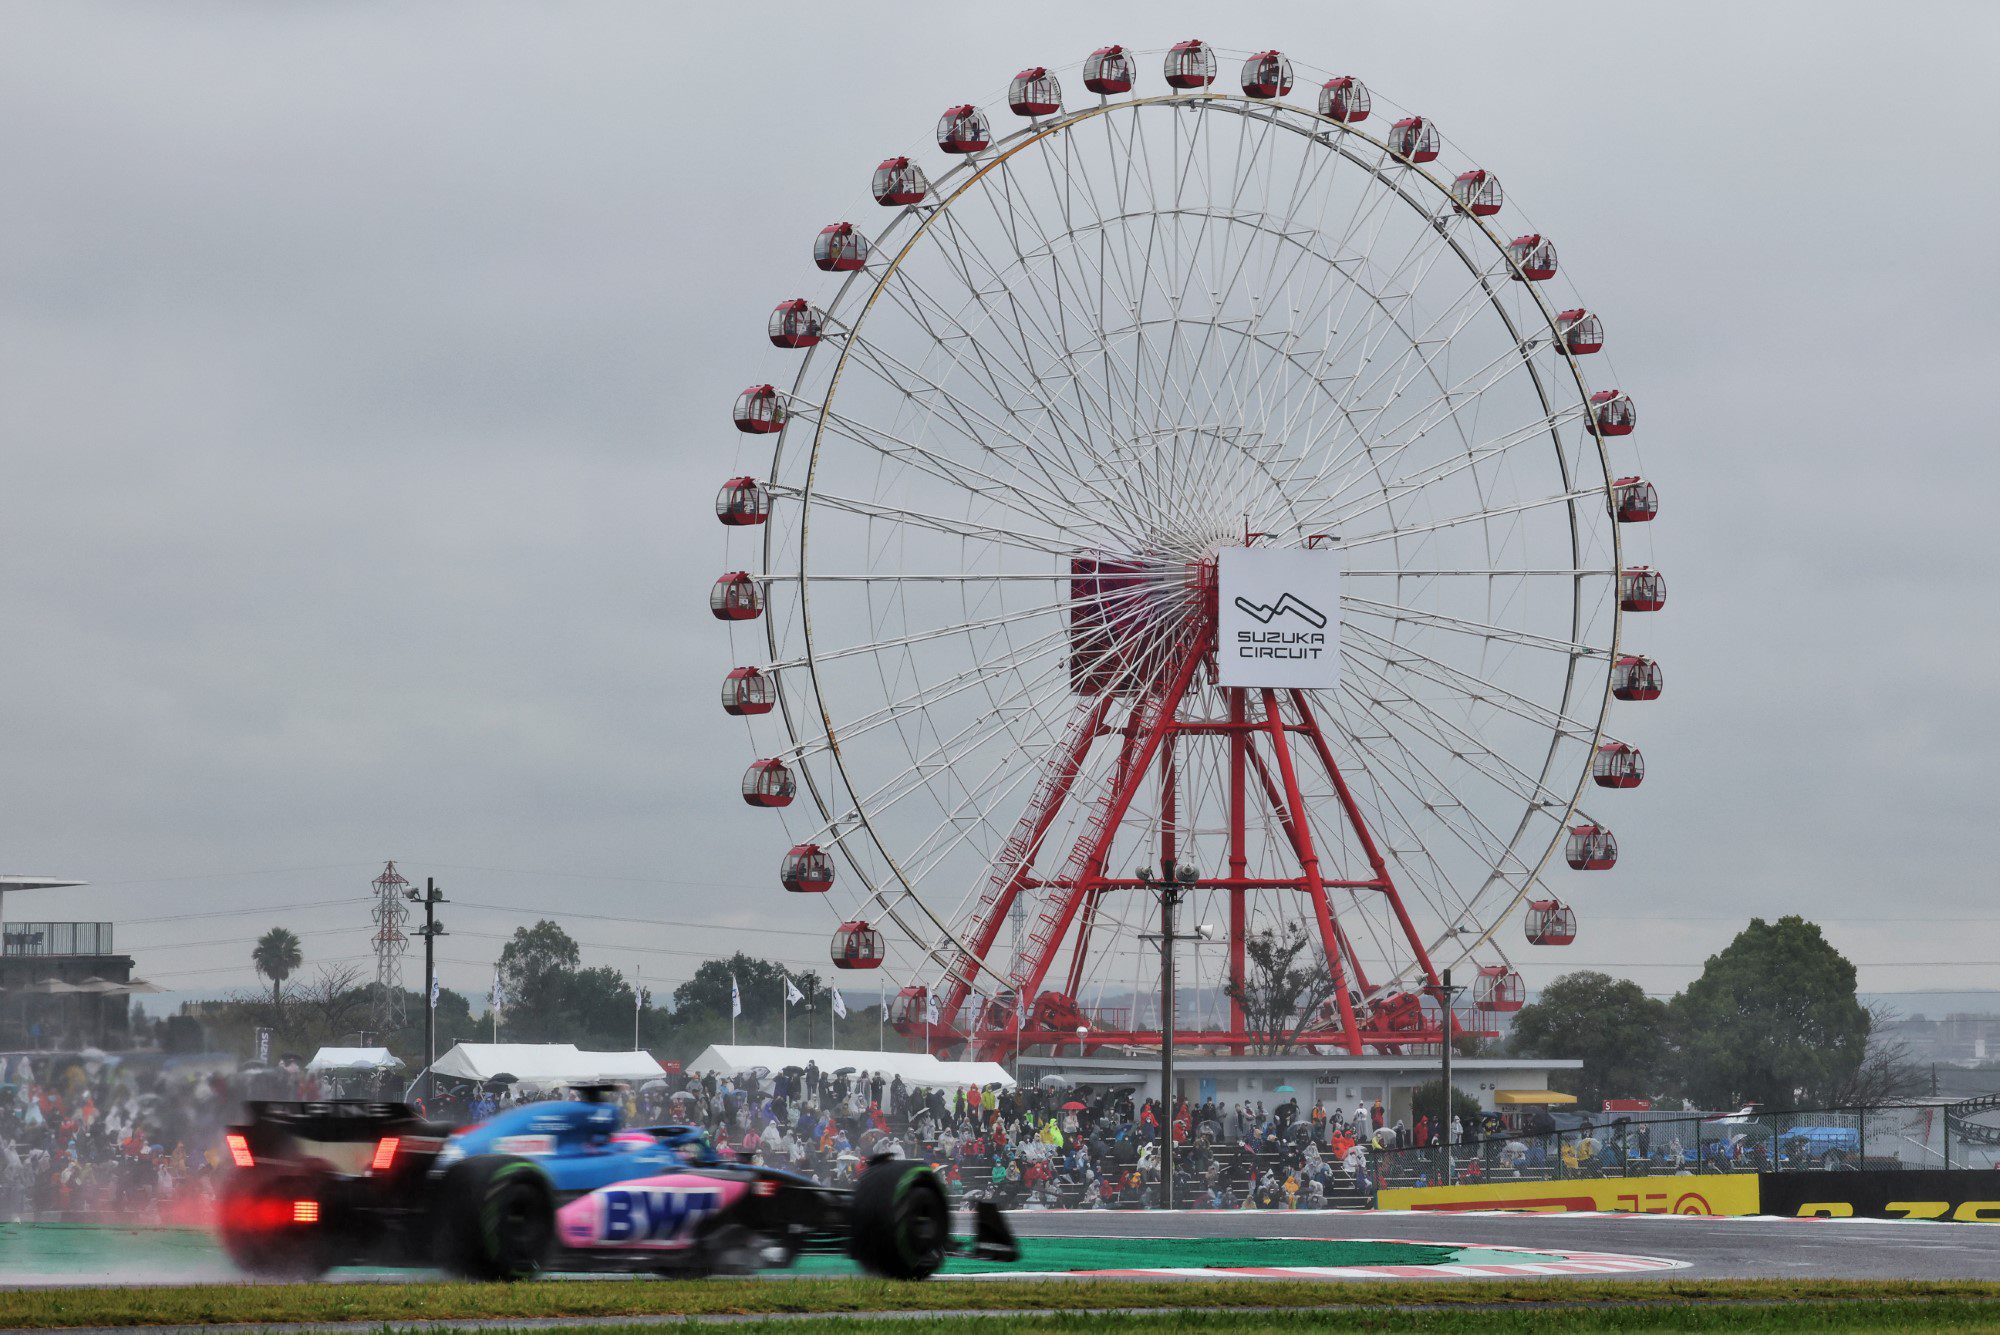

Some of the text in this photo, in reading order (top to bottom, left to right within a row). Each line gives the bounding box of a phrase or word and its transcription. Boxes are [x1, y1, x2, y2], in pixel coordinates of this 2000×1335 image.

[1237, 632, 1325, 645] SUZUKA
[1239, 647, 1322, 659] CIRCUIT
[1315, 1076, 1339, 1085] TOILET
[1605, 1101, 1611, 1110] S
